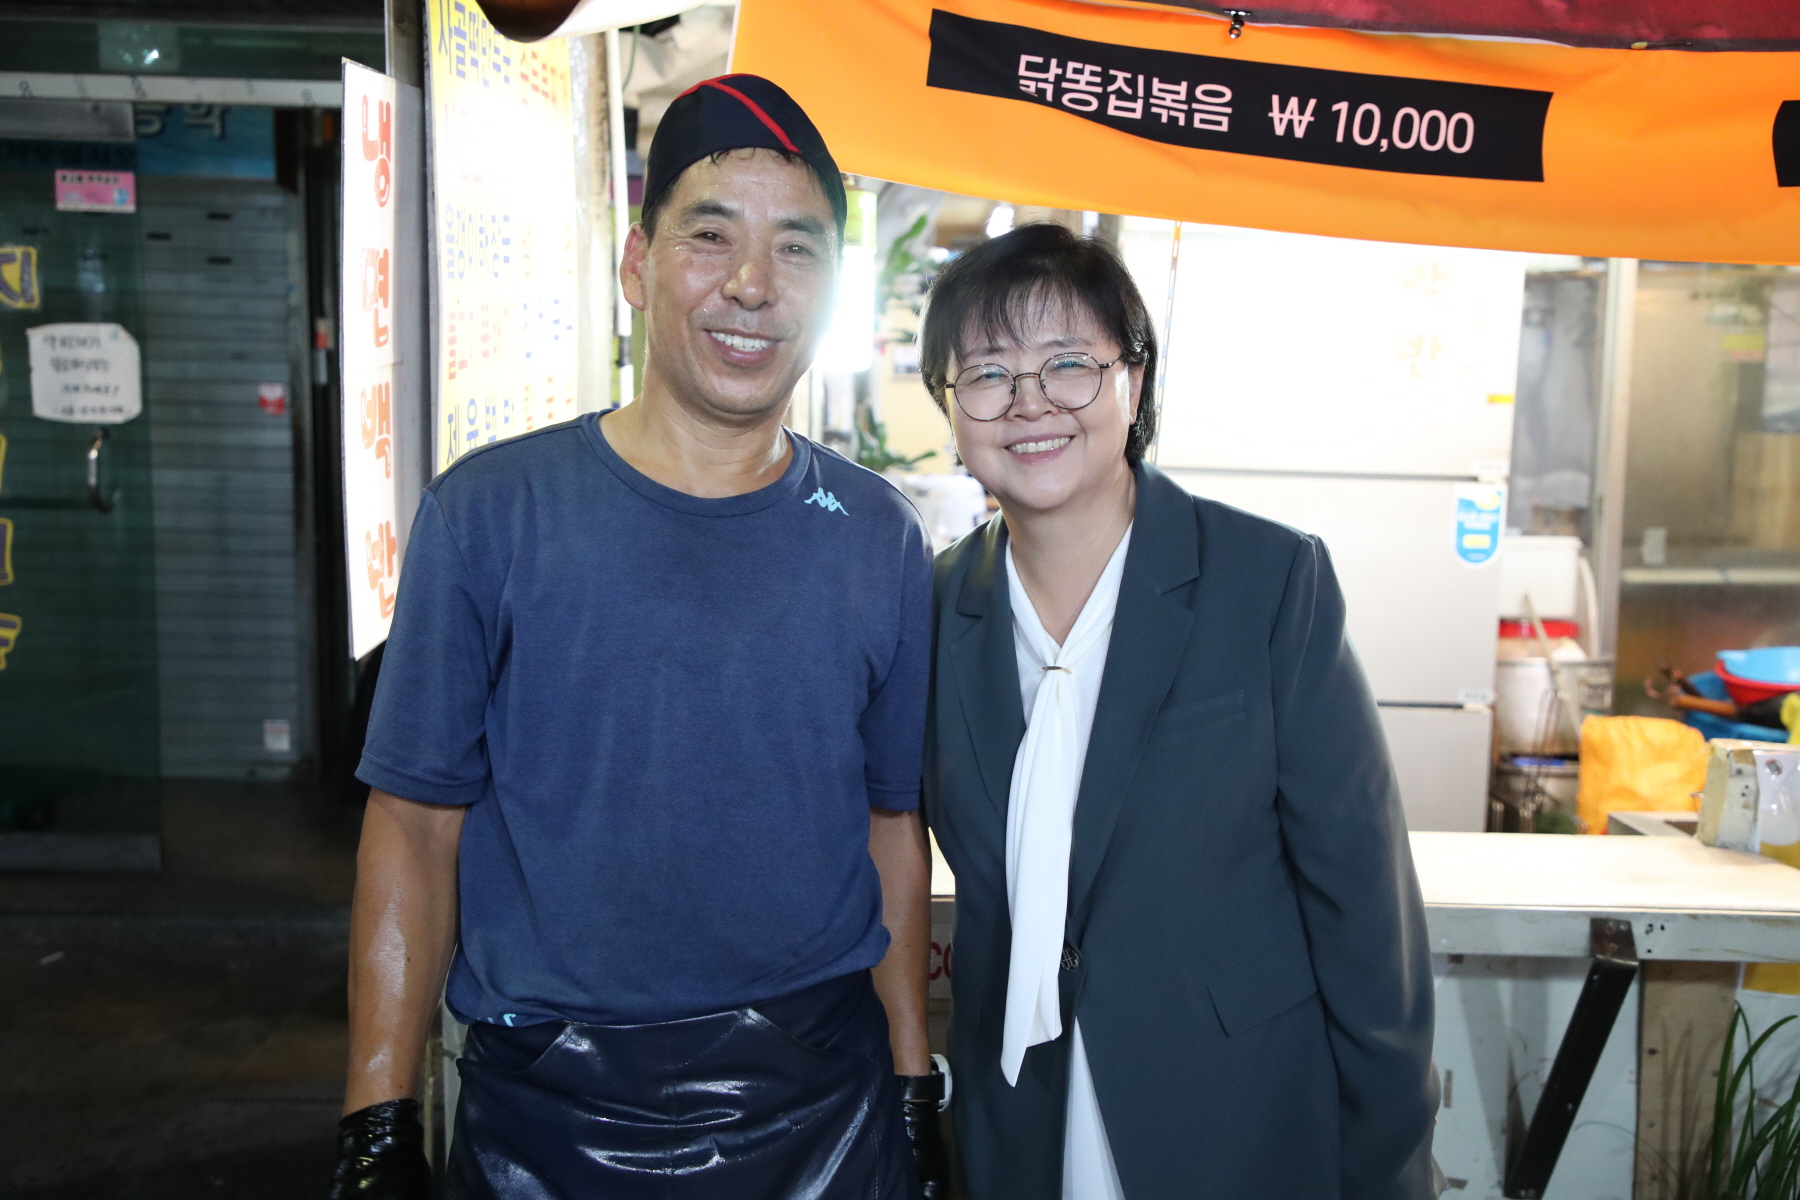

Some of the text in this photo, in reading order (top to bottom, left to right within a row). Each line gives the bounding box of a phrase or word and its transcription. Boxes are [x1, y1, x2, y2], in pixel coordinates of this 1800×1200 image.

[1017, 53, 1475, 154] 닭똥집볶음 ₩ 10,000
